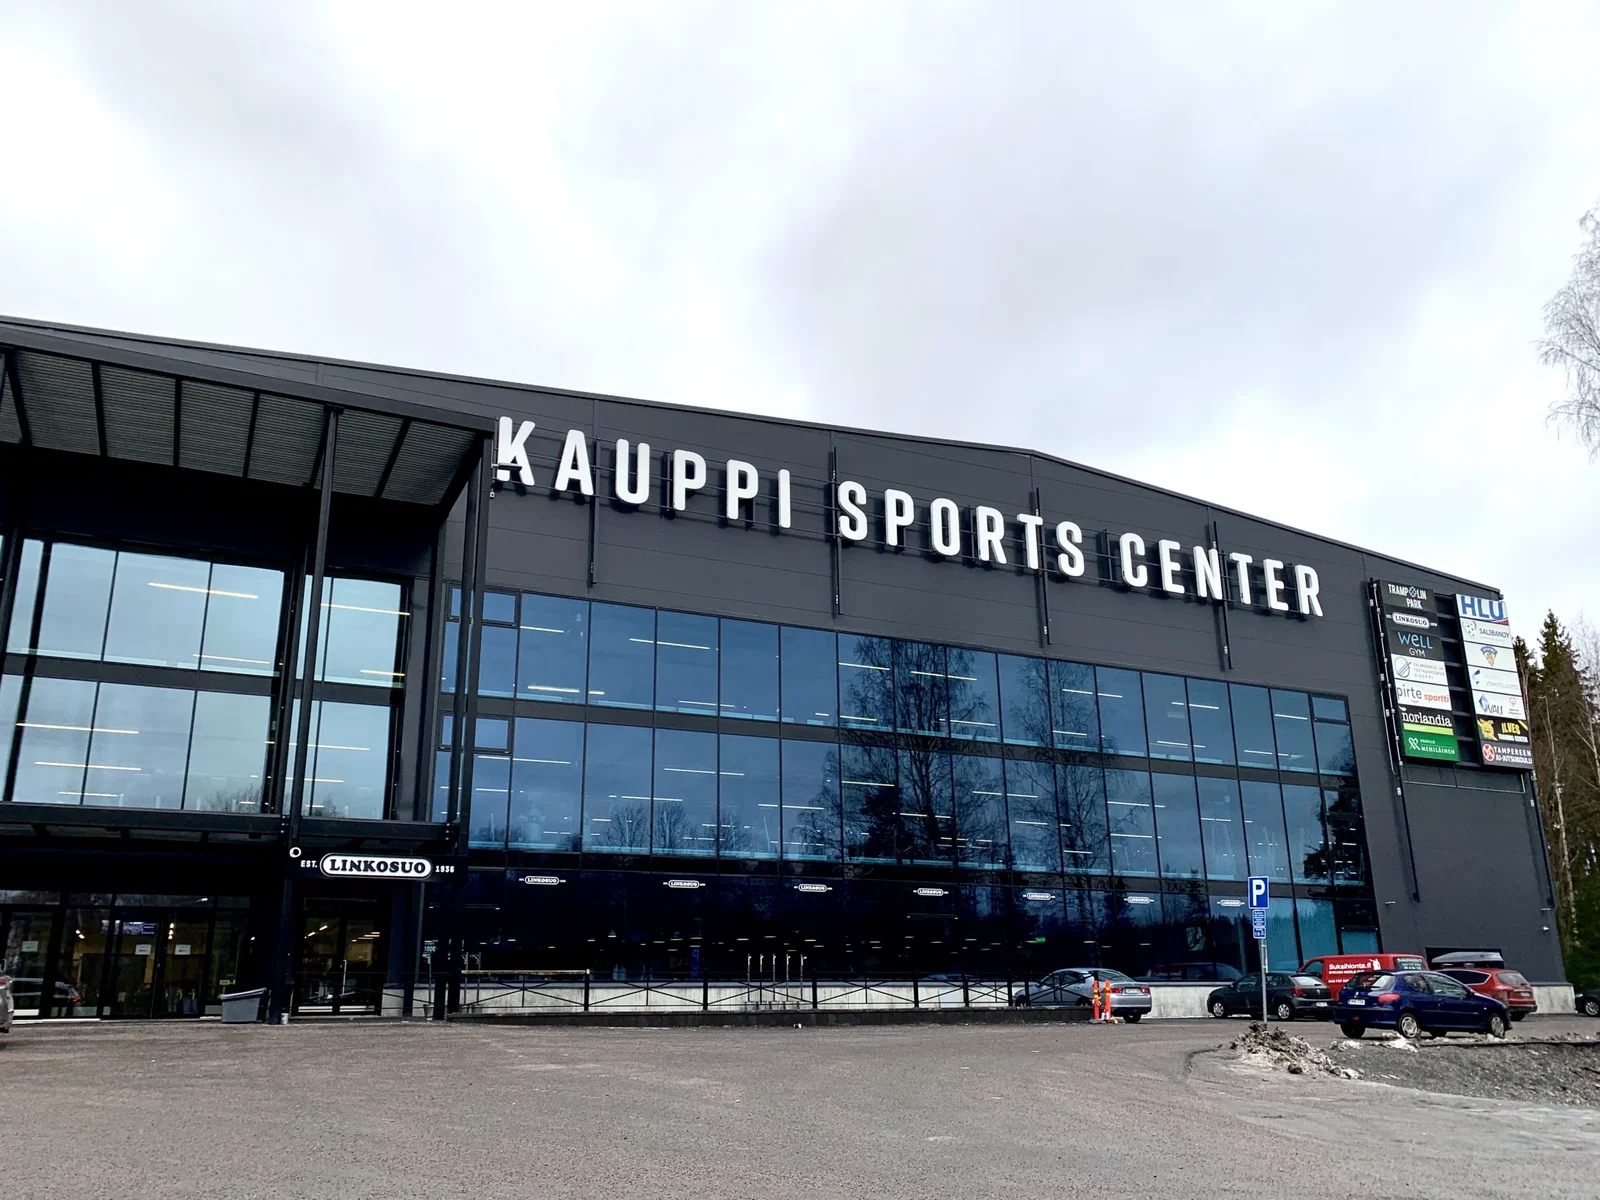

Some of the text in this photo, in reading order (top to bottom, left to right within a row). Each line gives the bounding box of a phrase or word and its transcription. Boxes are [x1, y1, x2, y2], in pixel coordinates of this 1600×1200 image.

[497, 416, 1324, 617] KAUPPI SPORTS CENTER
[1406, 598, 1423, 609] PARK
[1460, 595, 1504, 620] HLU
[1395, 614, 1428, 626] LINKOSUO
[1409, 647, 1426, 657] GYM
[1397, 684, 1450, 703] pirte sportti
[1401, 712, 1453, 727] norlandia
[1501, 722, 1520, 735] ILVES
[1494, 746, 1532, 757] TAMPEREEN
[300, 858, 455, 874] EST. LINKOSUO 1936
[1252, 879, 1266, 906] P
